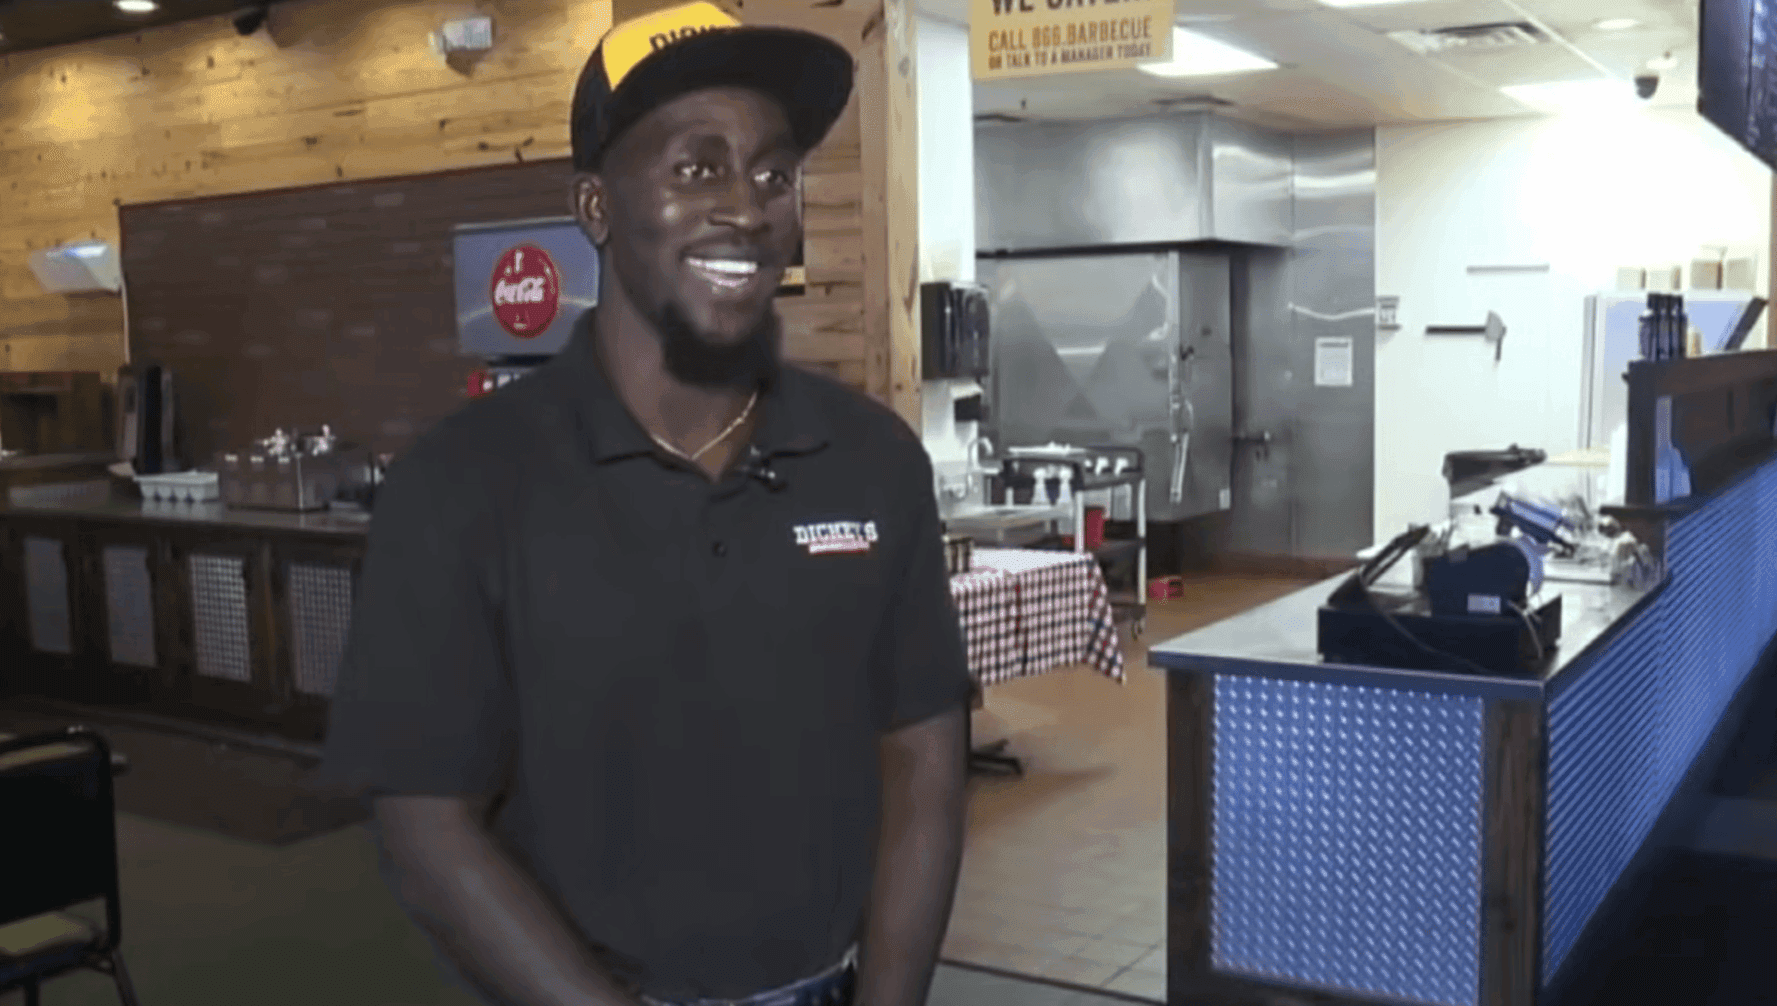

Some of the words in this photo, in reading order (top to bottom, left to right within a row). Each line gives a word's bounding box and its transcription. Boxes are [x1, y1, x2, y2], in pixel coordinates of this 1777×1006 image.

[988, 28, 1027, 52] CALL
[1007, 52, 1030, 67] TALK
[1035, 50, 1047, 67] TO
[1051, 51, 1058, 65] A
[1061, 45, 1113, 64] MANAGER
